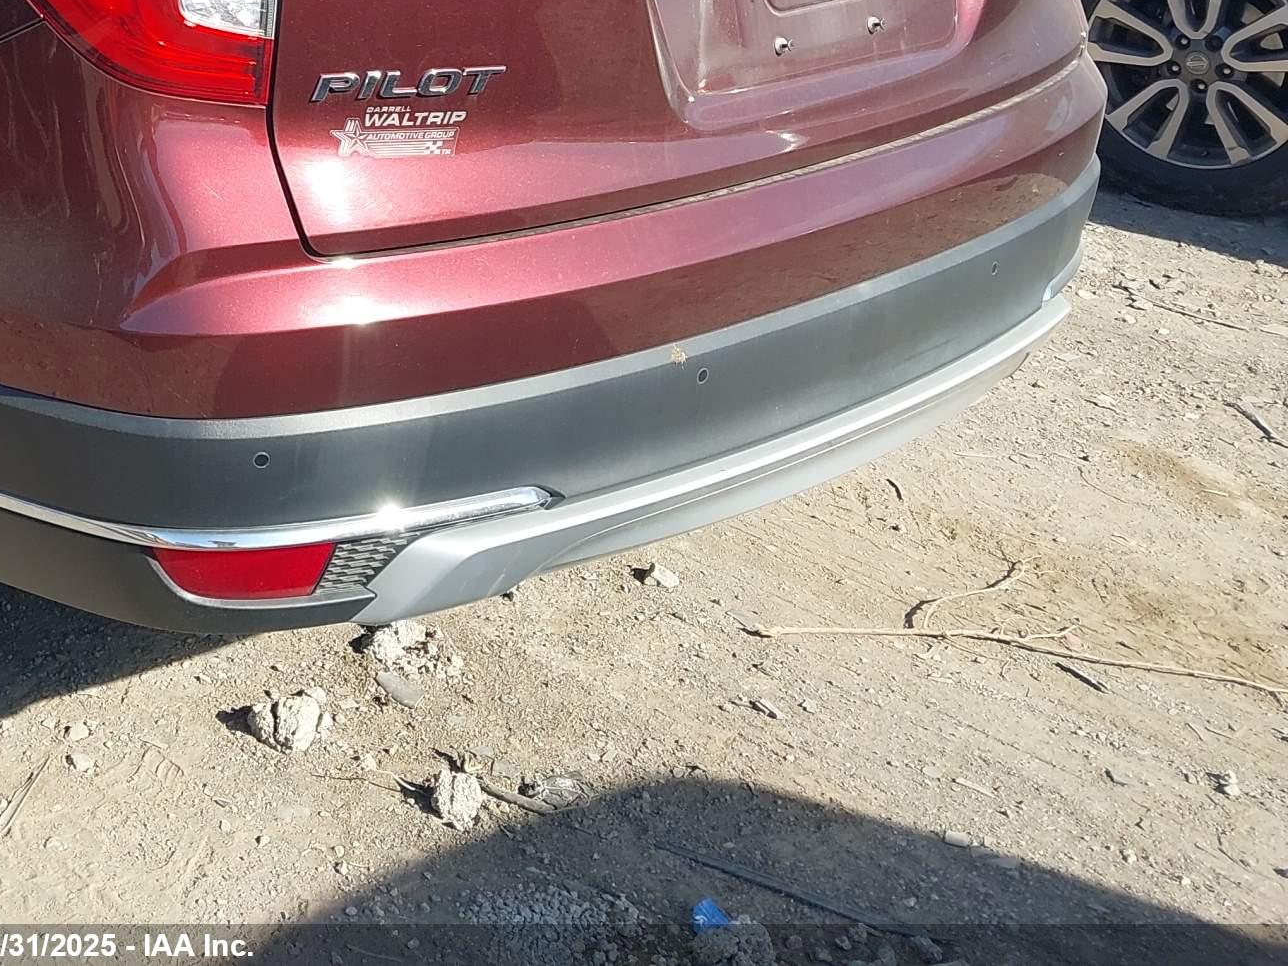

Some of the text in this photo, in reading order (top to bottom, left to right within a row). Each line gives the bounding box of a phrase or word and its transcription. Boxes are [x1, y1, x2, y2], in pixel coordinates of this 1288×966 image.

[310, 65, 507, 103] PILOT
[365, 105, 412, 113] DARRELL
[364, 111, 467, 128] WALTRIP
[367, 131, 455, 140] AUTOMOTIVE GROUP
